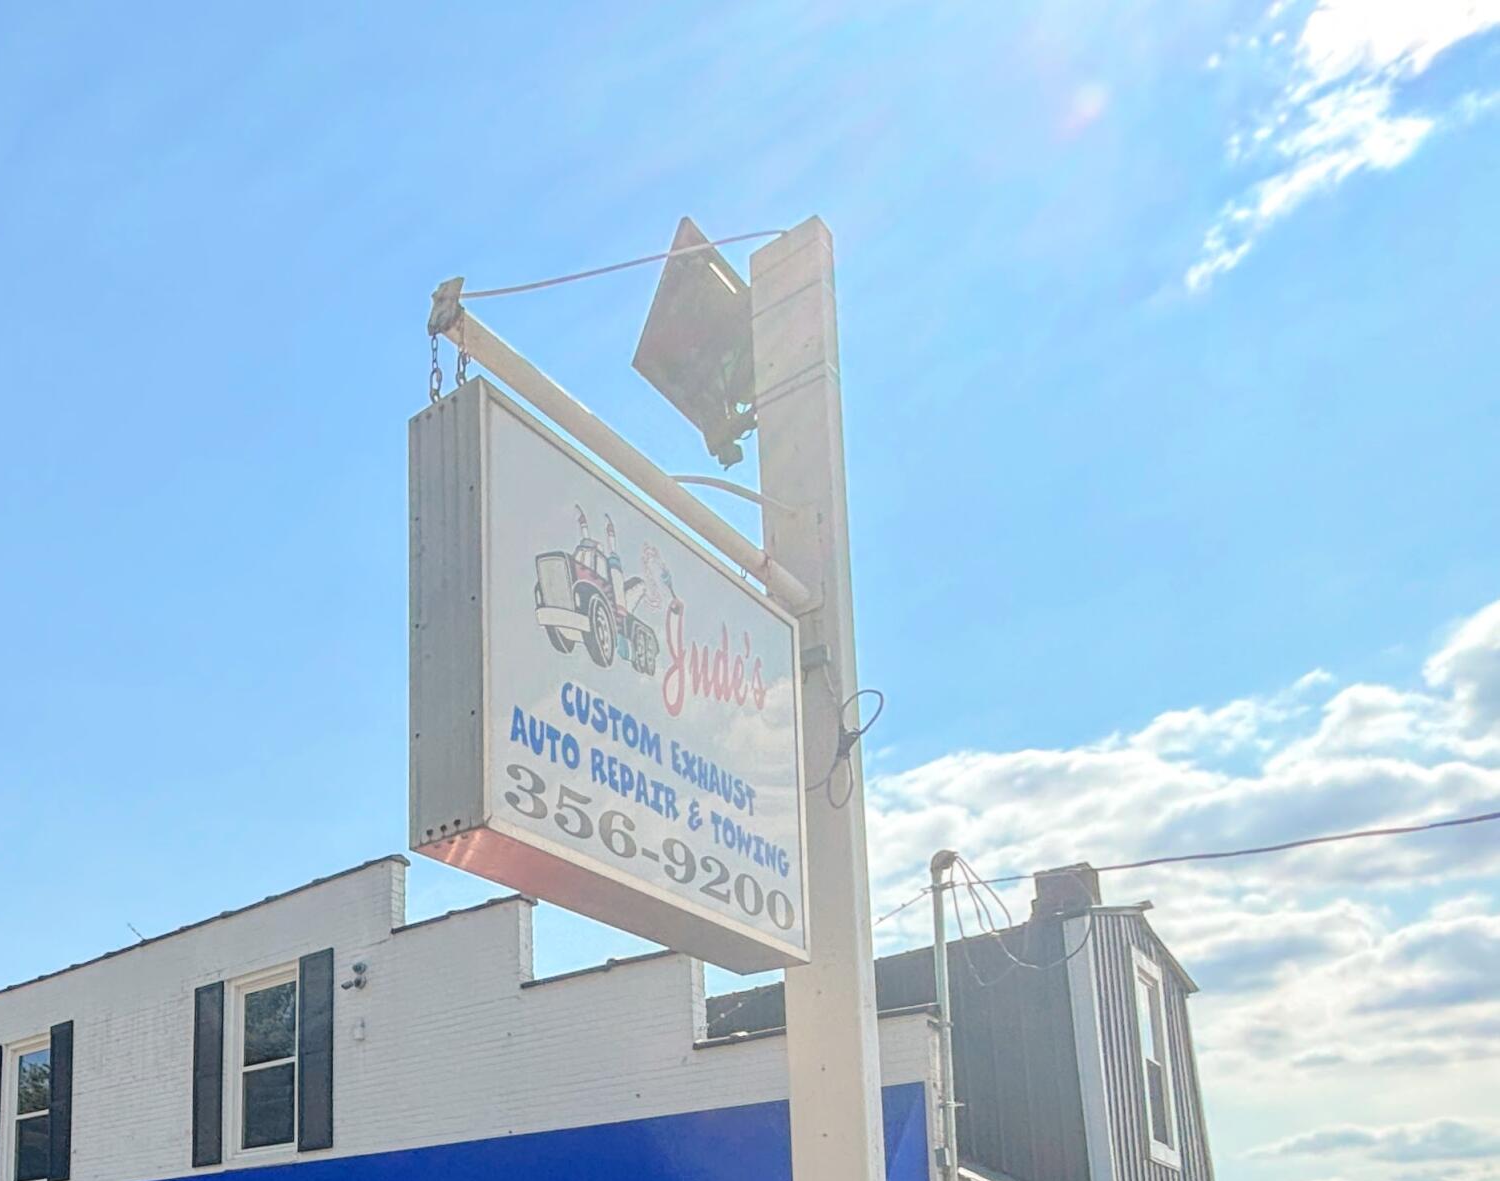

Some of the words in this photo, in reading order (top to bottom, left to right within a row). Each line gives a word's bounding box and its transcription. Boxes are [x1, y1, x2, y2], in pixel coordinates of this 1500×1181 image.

[662, 599, 767, 717] Jude's
[510, 704, 580, 770] AUTO
[590, 747, 680, 822] REPAIR
[687, 799, 702, 832] &
[710, 810, 790, 878] TOWING
[561, 681, 662, 765] CUSTOM
[671, 740, 756, 817] EXHAUST
[504, 763, 795, 931] 356-9200
